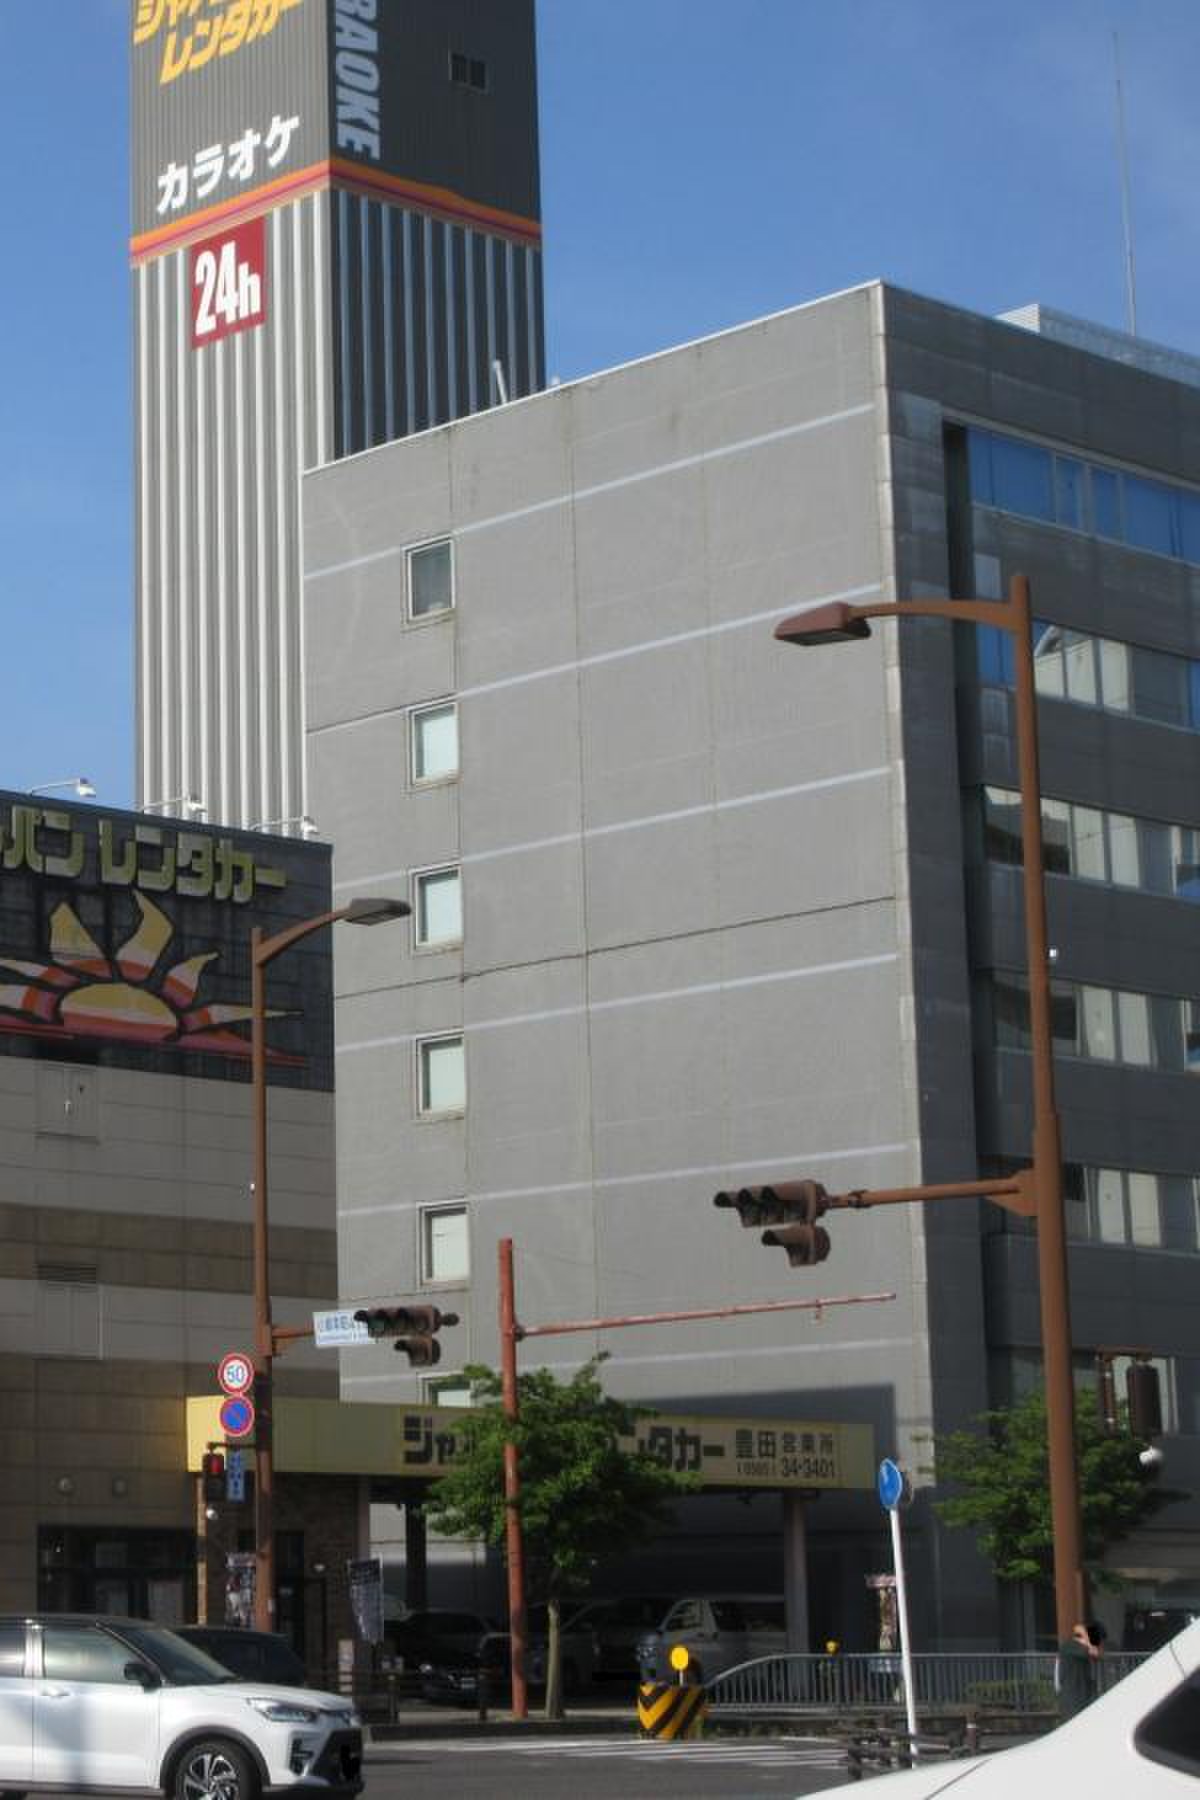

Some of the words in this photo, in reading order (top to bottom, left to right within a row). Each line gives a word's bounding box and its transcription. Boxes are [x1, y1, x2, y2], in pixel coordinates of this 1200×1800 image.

[156, 113, 300, 215] カラオケ
[195, 241, 262, 337] 24h
[99, 818, 287, 902] レンタカー
